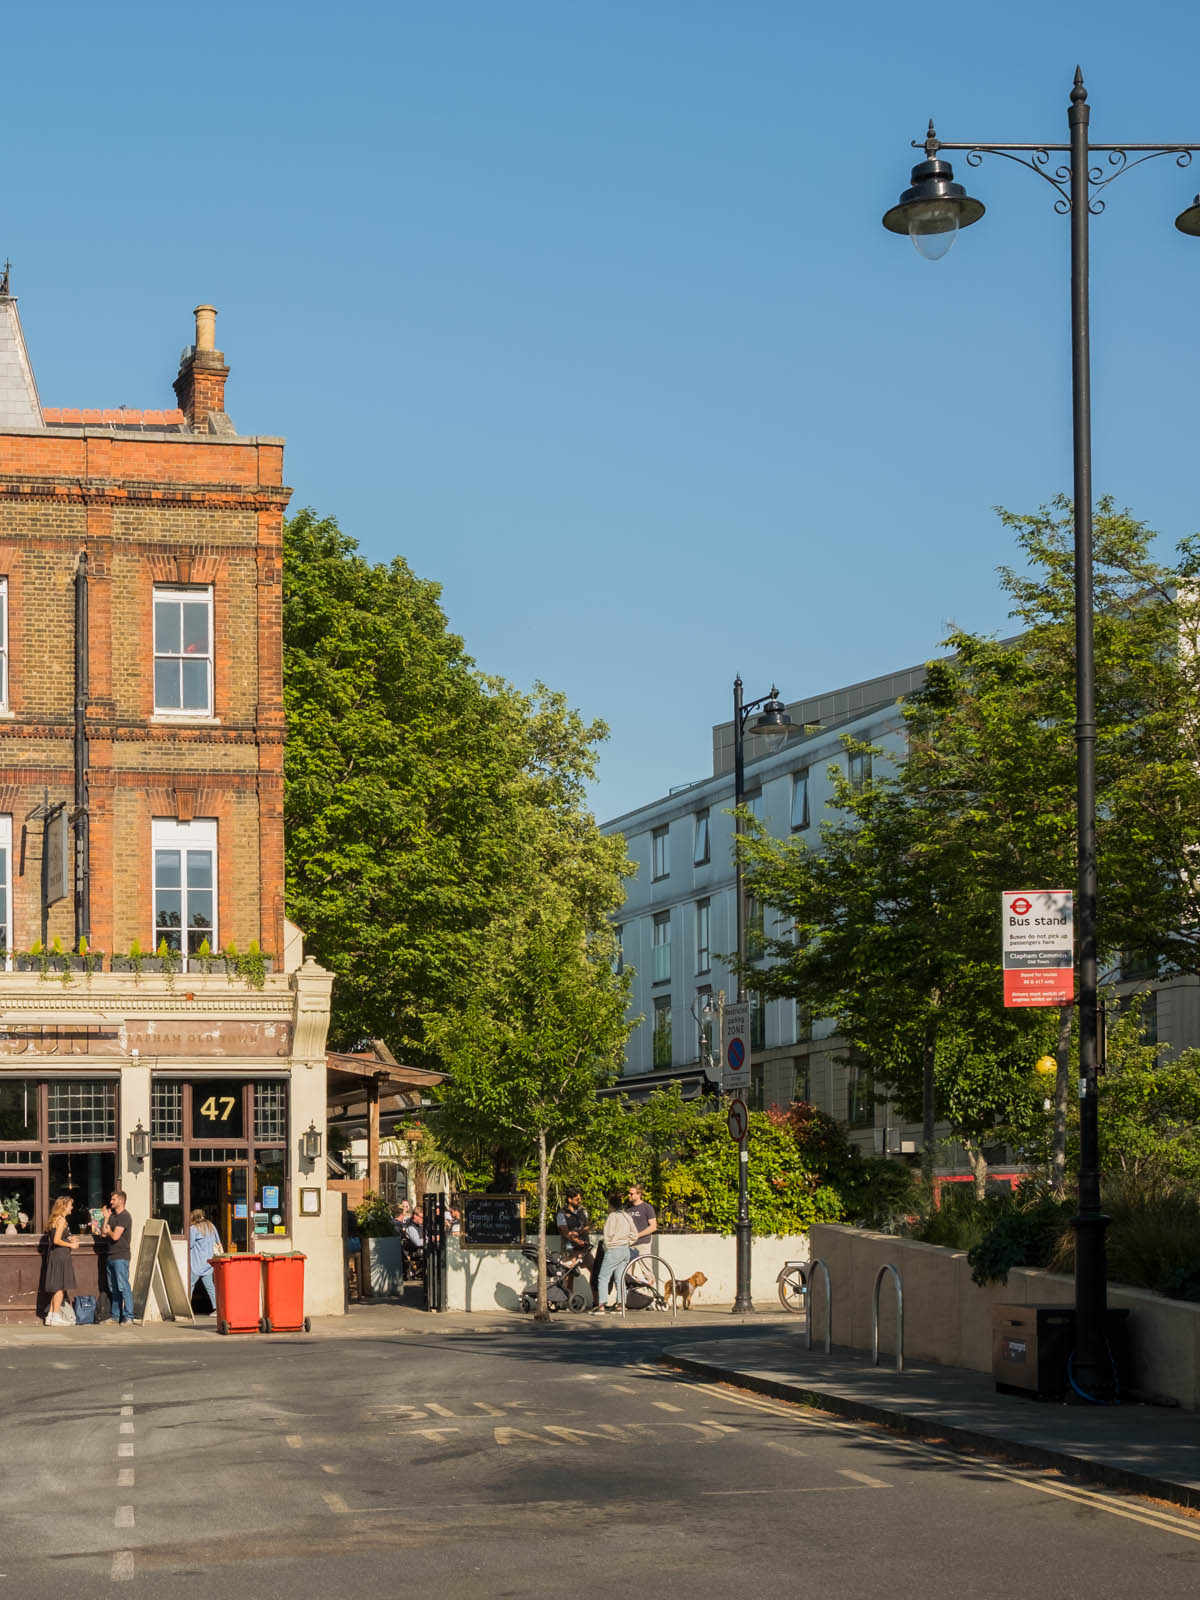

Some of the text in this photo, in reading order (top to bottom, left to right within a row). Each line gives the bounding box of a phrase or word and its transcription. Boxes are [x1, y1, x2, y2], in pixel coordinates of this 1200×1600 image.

[1009, 916, 1067, 926] Bus stand
[728, 1024, 745, 1036] ZONE
[200, 1096, 236, 1120] 47
